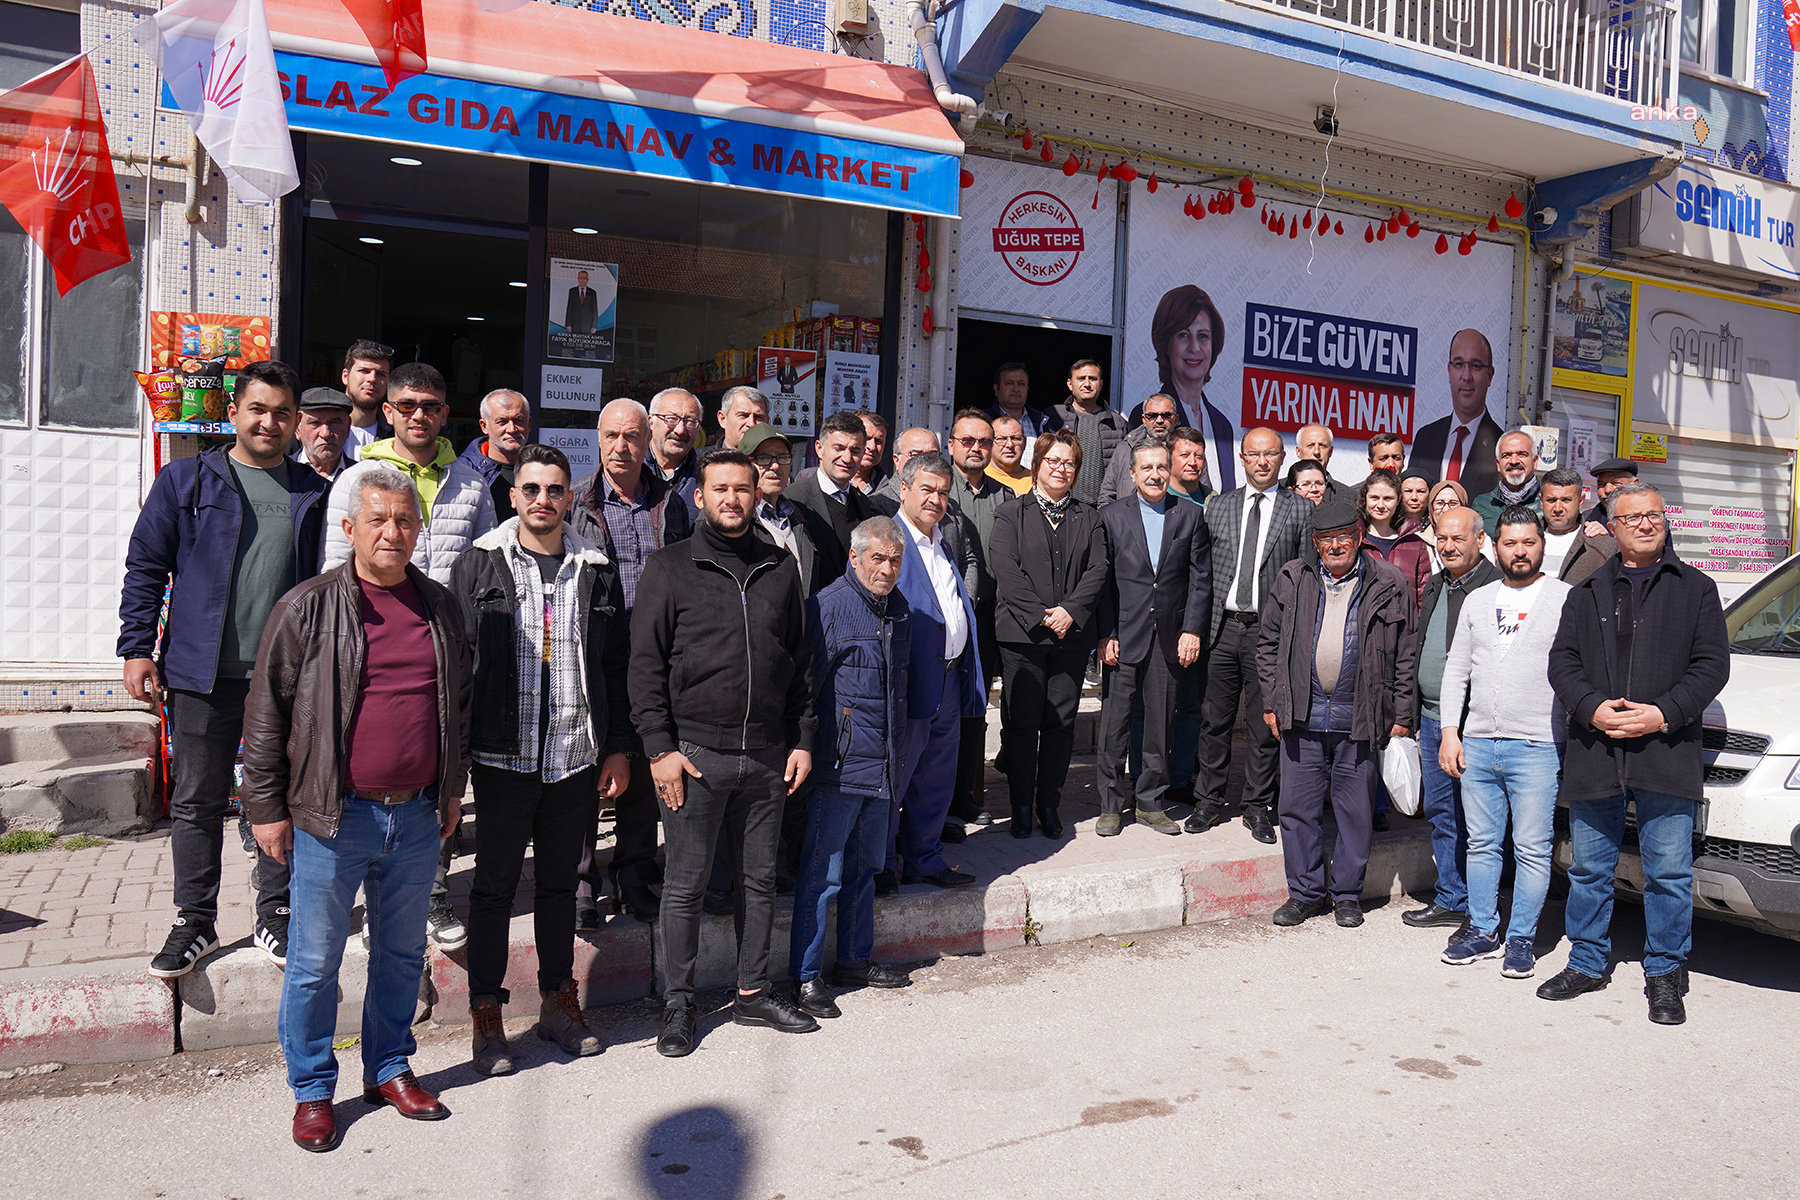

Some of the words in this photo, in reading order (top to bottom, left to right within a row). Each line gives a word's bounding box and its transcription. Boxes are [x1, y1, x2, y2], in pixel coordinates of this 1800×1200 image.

[408, 93, 521, 137] GIDA
[537, 111, 694, 160] MANAV
[708, 138, 737, 167] &
[752, 143, 917, 192] MARKET
[1008, 202, 1067, 224] HERKESİN
[69, 202, 115, 245] CHP
[998, 230, 1040, 246] UĞUR
[1044, 233, 1080, 246] TEPE
[1767, 216, 1795, 248] TUR
[1015, 256, 1067, 277] BAŞKANI
[546, 374, 582, 384] EKMEK
[546, 390, 596, 402] BULUNUR
[1251, 377, 1343, 428] YARINA
[549, 435, 589, 447] SİGARA
[253, 503, 291, 514] TAN
[1725, 549, 1750, 557] SANDALYE
[1694, 561, 1704, 569] 544
[1705, 561, 1714, 569] 339
[1743, 563, 1752, 571] 544
